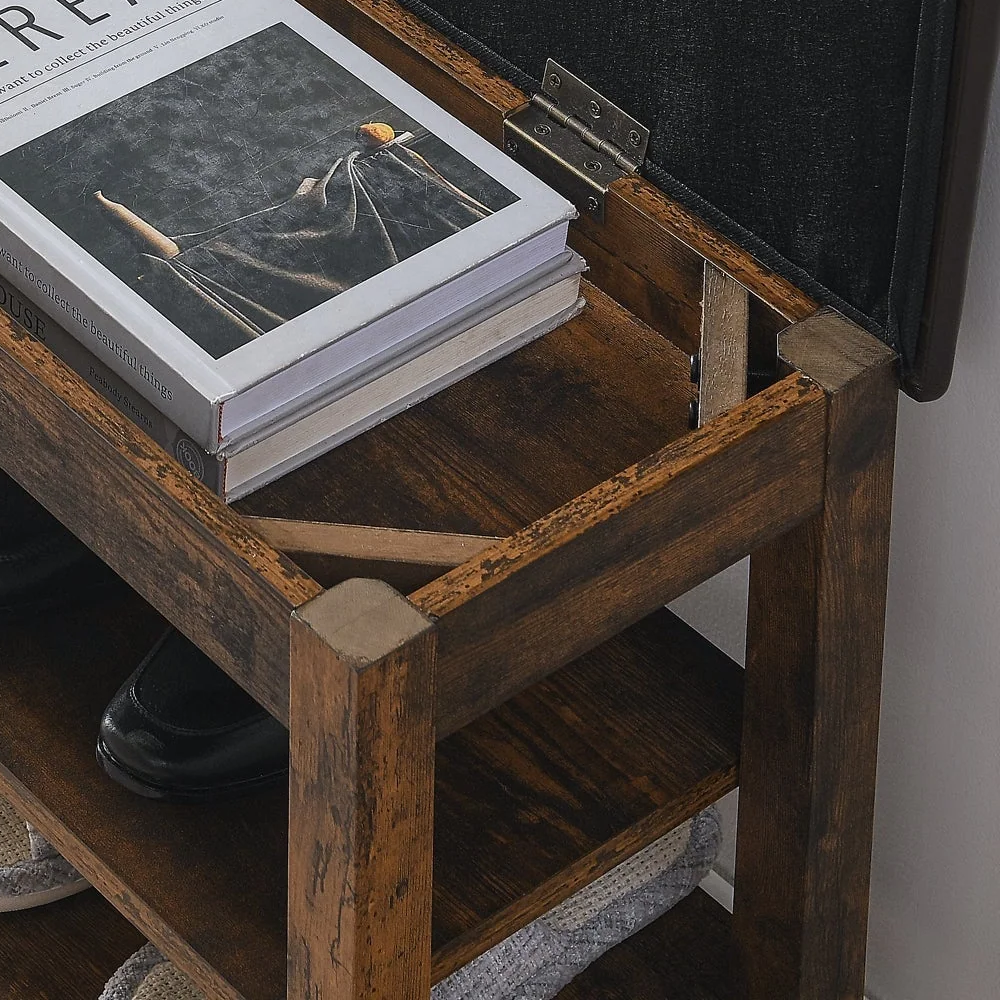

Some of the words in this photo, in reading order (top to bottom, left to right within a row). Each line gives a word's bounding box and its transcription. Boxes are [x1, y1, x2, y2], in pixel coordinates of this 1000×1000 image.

[28, 69, 44, 79] to
[44, 49, 87, 72] collect
[85, 38, 109, 52] the
[107, 12, 166, 42] beautiful
[24, 266, 35, 282] to
[36, 278, 71, 313] collect
[71, 306, 88, 328] the
[90, 320, 138, 370] beautiful
[139, 364, 174, 401] things
